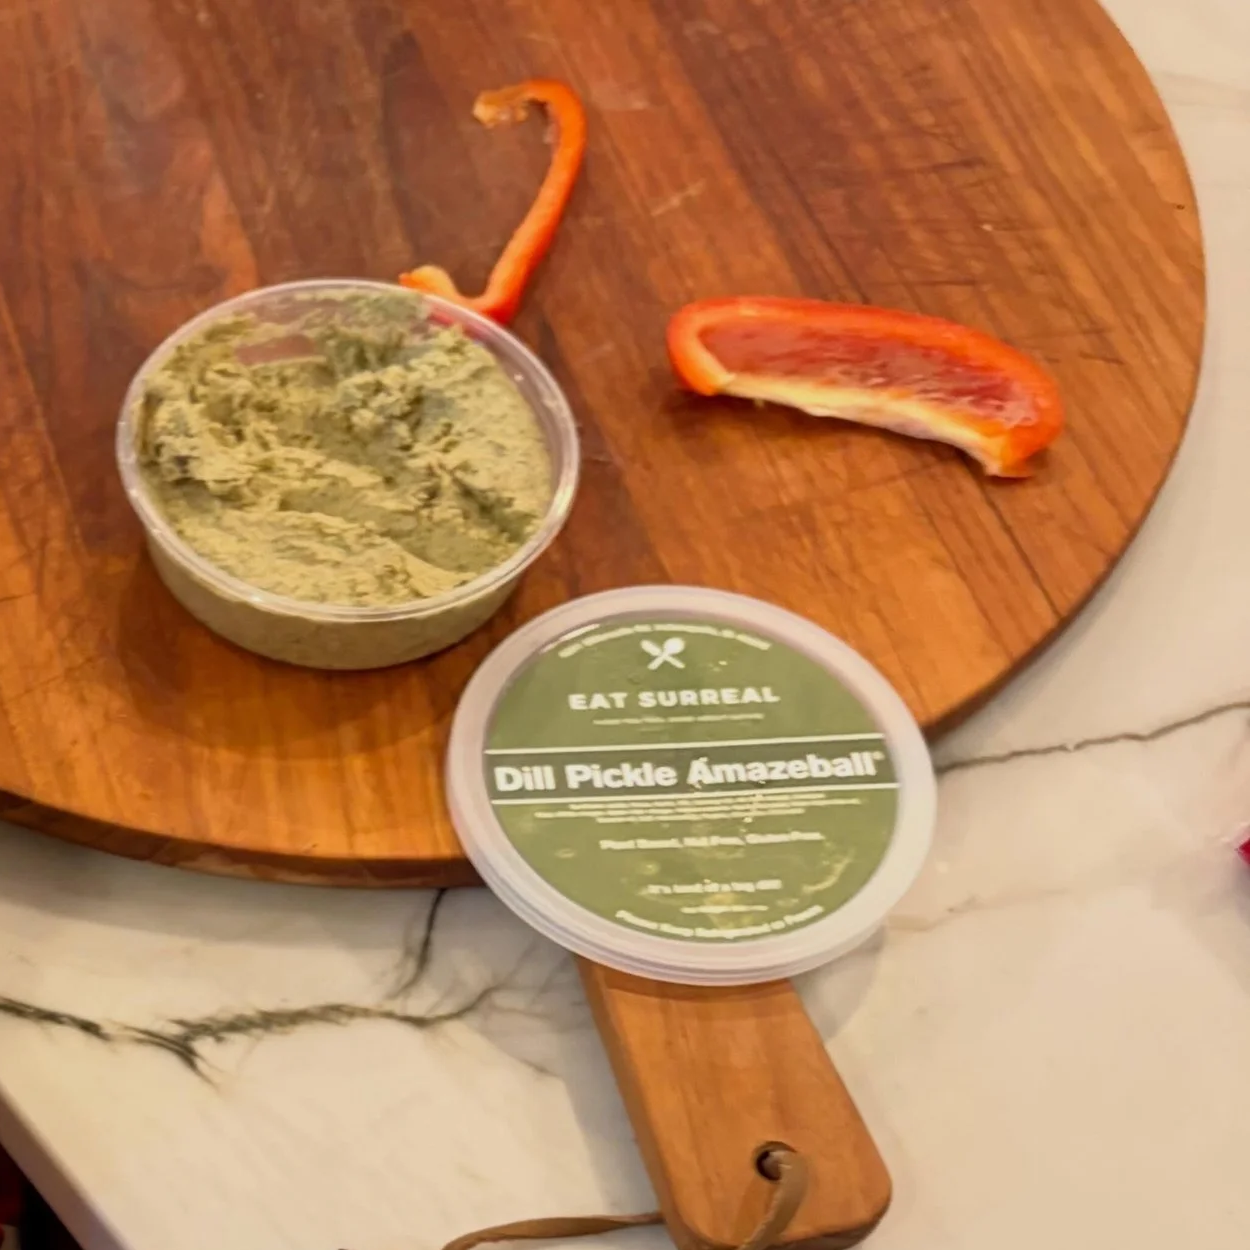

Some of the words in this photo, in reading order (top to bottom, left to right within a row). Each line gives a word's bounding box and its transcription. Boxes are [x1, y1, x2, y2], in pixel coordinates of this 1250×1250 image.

[567, 691, 628, 710] EAT
[637, 686, 781, 708] SURREAL
[493, 764, 556, 792] Dill
[564, 761, 678, 789] Pickle
